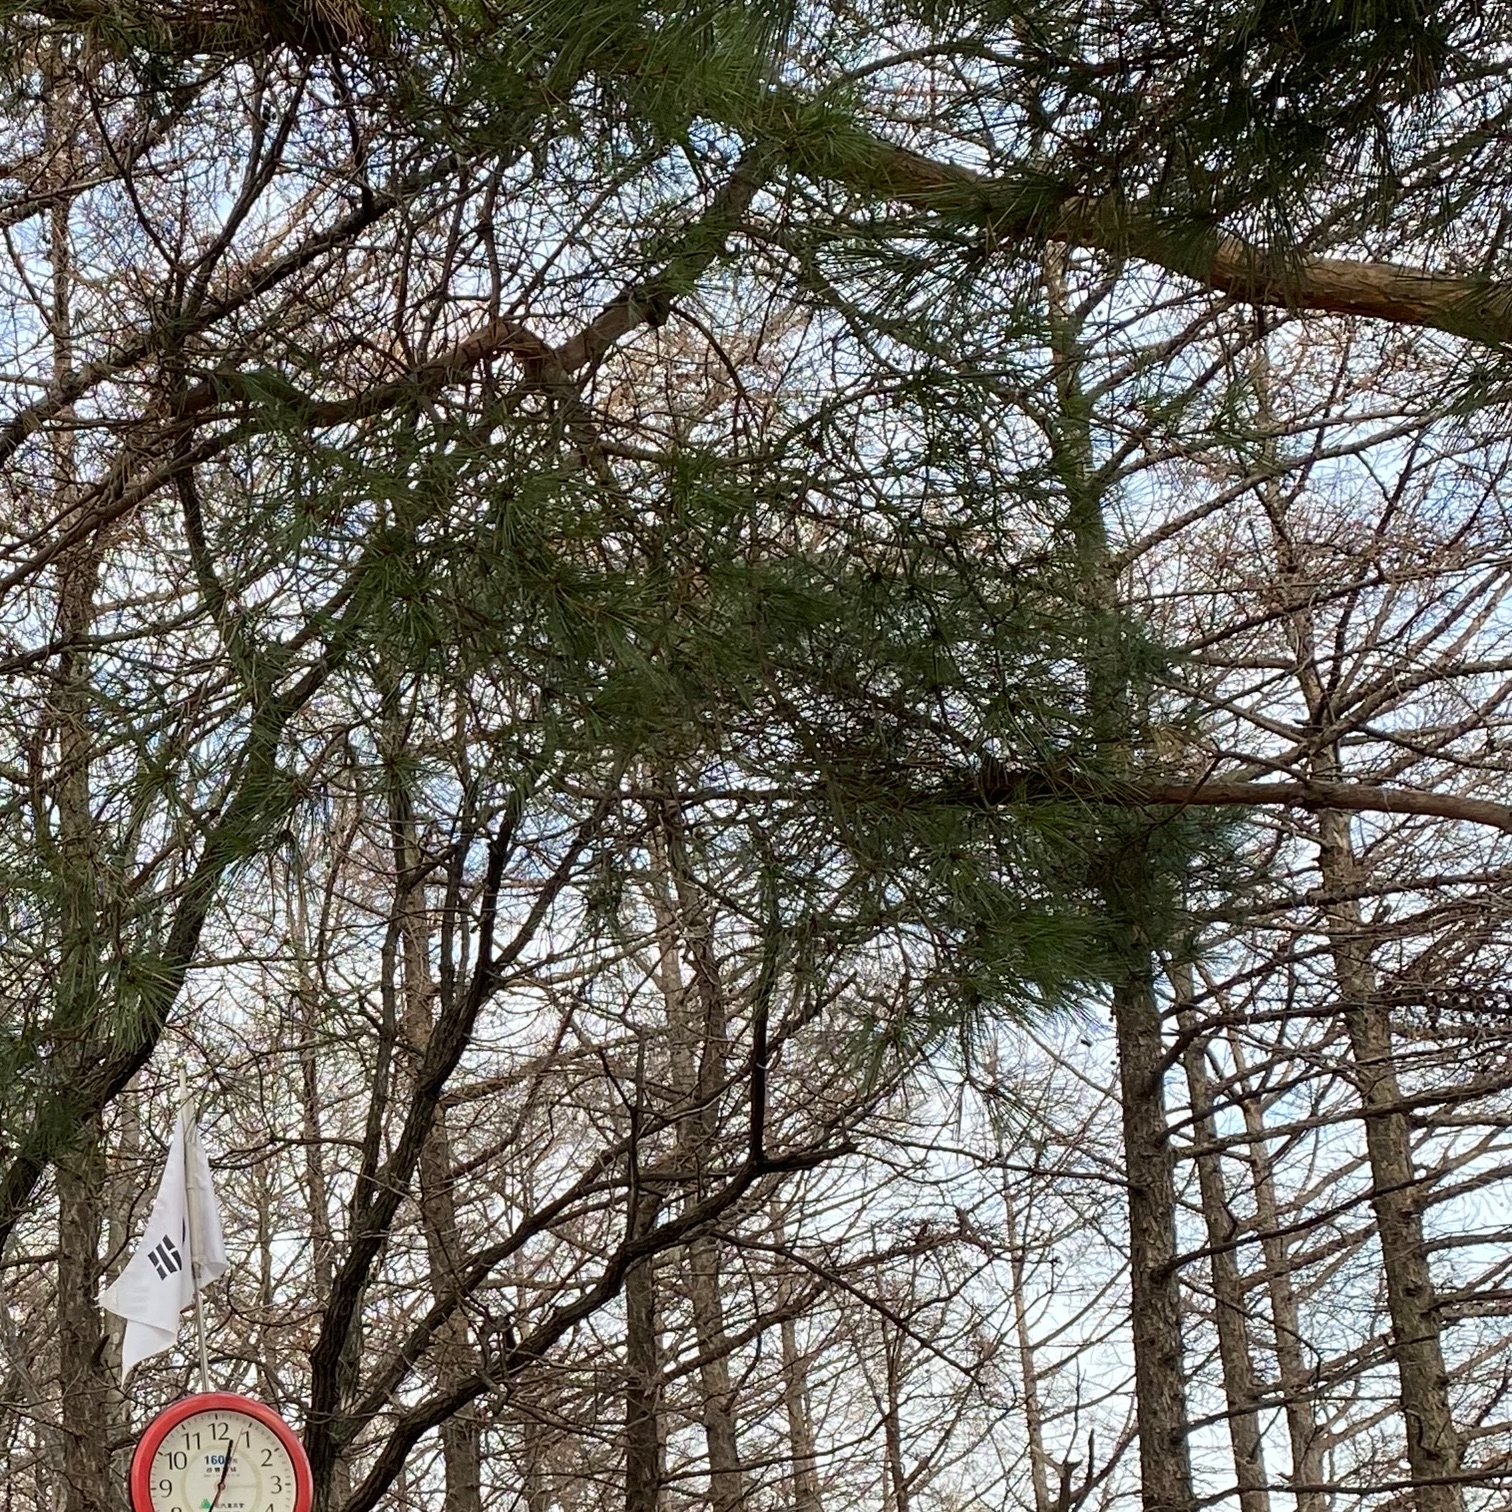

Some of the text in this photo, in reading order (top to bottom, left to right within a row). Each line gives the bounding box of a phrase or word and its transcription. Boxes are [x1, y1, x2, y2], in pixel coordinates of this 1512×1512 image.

[208, 1422, 229, 1440] 12
[243, 1431, 250, 1448] 1
[182, 1432, 201, 1450] 11
[166, 1452, 187, 1470] 10
[261, 1449, 273, 1466] 2
[159, 1479, 172, 1497] 9
[270, 1476, 282, 1494] 3
